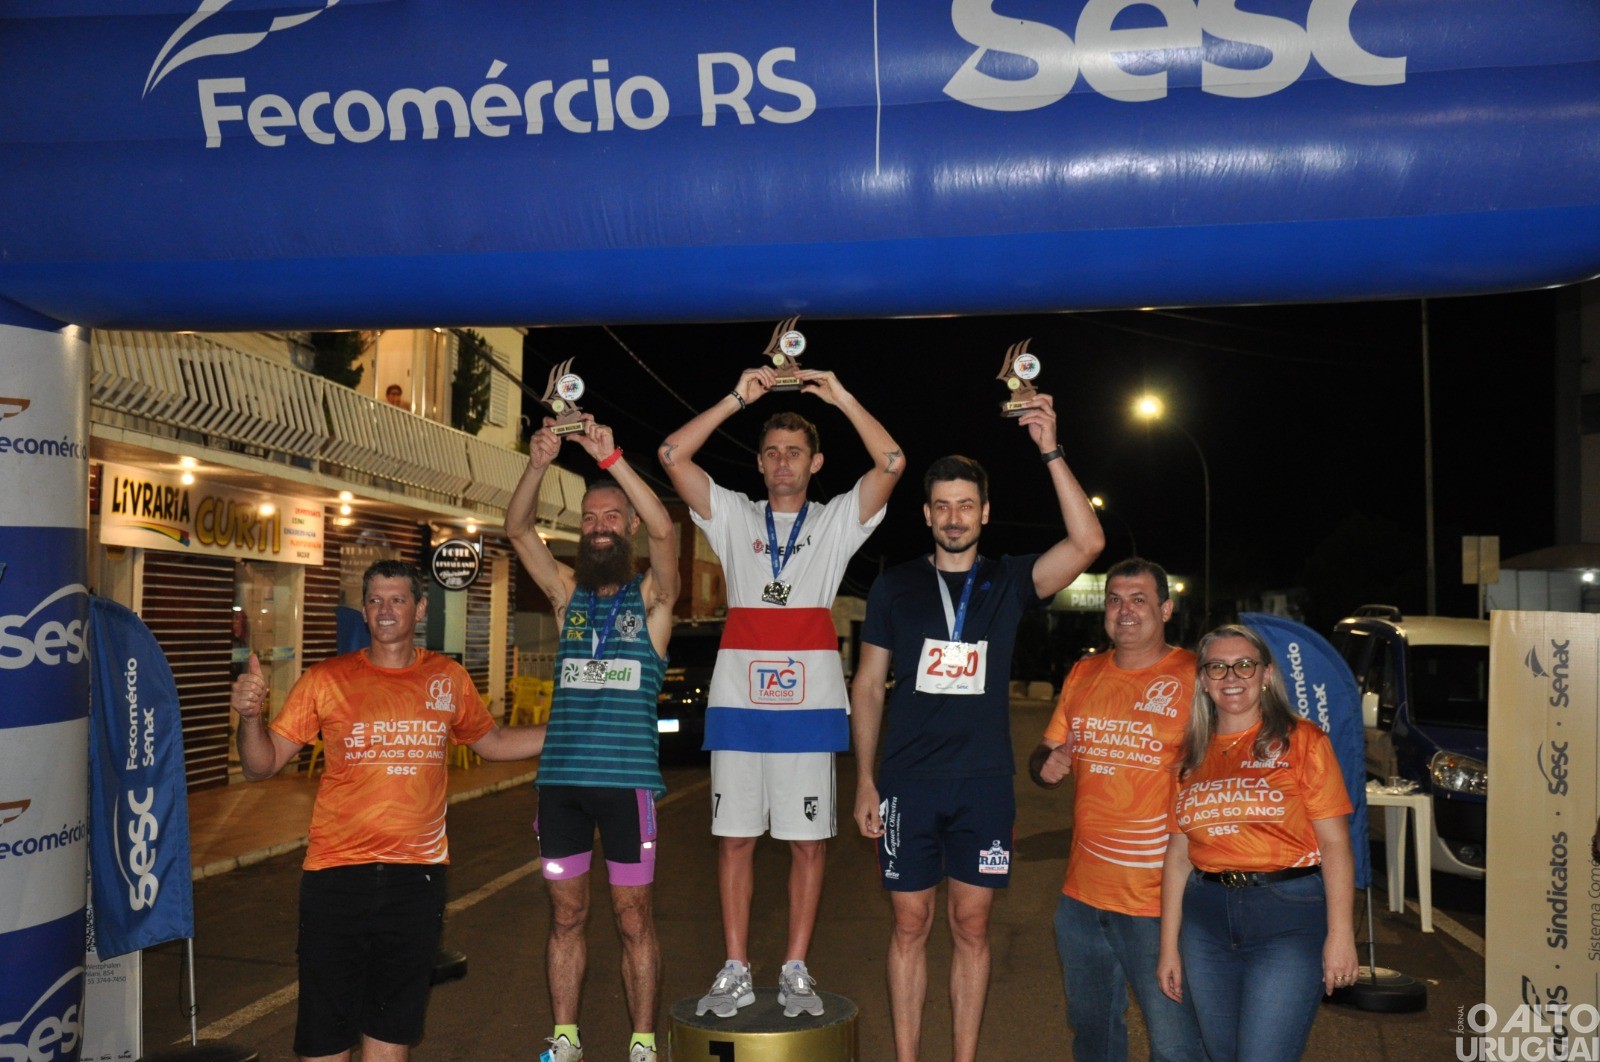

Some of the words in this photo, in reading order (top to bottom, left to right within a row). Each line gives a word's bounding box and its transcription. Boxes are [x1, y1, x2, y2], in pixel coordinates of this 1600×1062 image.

[198, 58, 670, 149] Fecomércio
[698, 46, 816, 127] RS
[195, 496, 281, 554] CURTI
[757, 669, 797, 690] TAG
[1287, 642, 1310, 720] comércio
[1146, 681, 1179, 701] 60
[124, 657, 138, 770] Fecomércio
[373, 719, 447, 734] RÚSTICA
[1086, 716, 1154, 737] RÚSTICA
[344, 736, 365, 748] DE
[1084, 731, 1163, 752] PLANALTO
[345, 750, 376, 760] RUMO
[379, 750, 405, 758] AOS
[408, 750, 424, 758] 60
[1087, 747, 1108, 757] AOS
[1110, 749, 1125, 759] 60
[1127, 752, 1162, 765] ANOS
[1189, 778, 1270, 796] RÚSTICA
[714, 793, 722, 818] 7
[1184, 789, 1284, 811] PLANALTO
[1194, 807, 1220, 822] AOS
[1222, 807, 1241, 817] 60
[1245, 806, 1285, 816] ANOS
[0, 820, 86, 859] ecomércio
[980, 856, 1008, 866] RAJA
[1547, 831, 1568, 950] Sindicatos
[1588, 904, 1600, 961] Sistema
